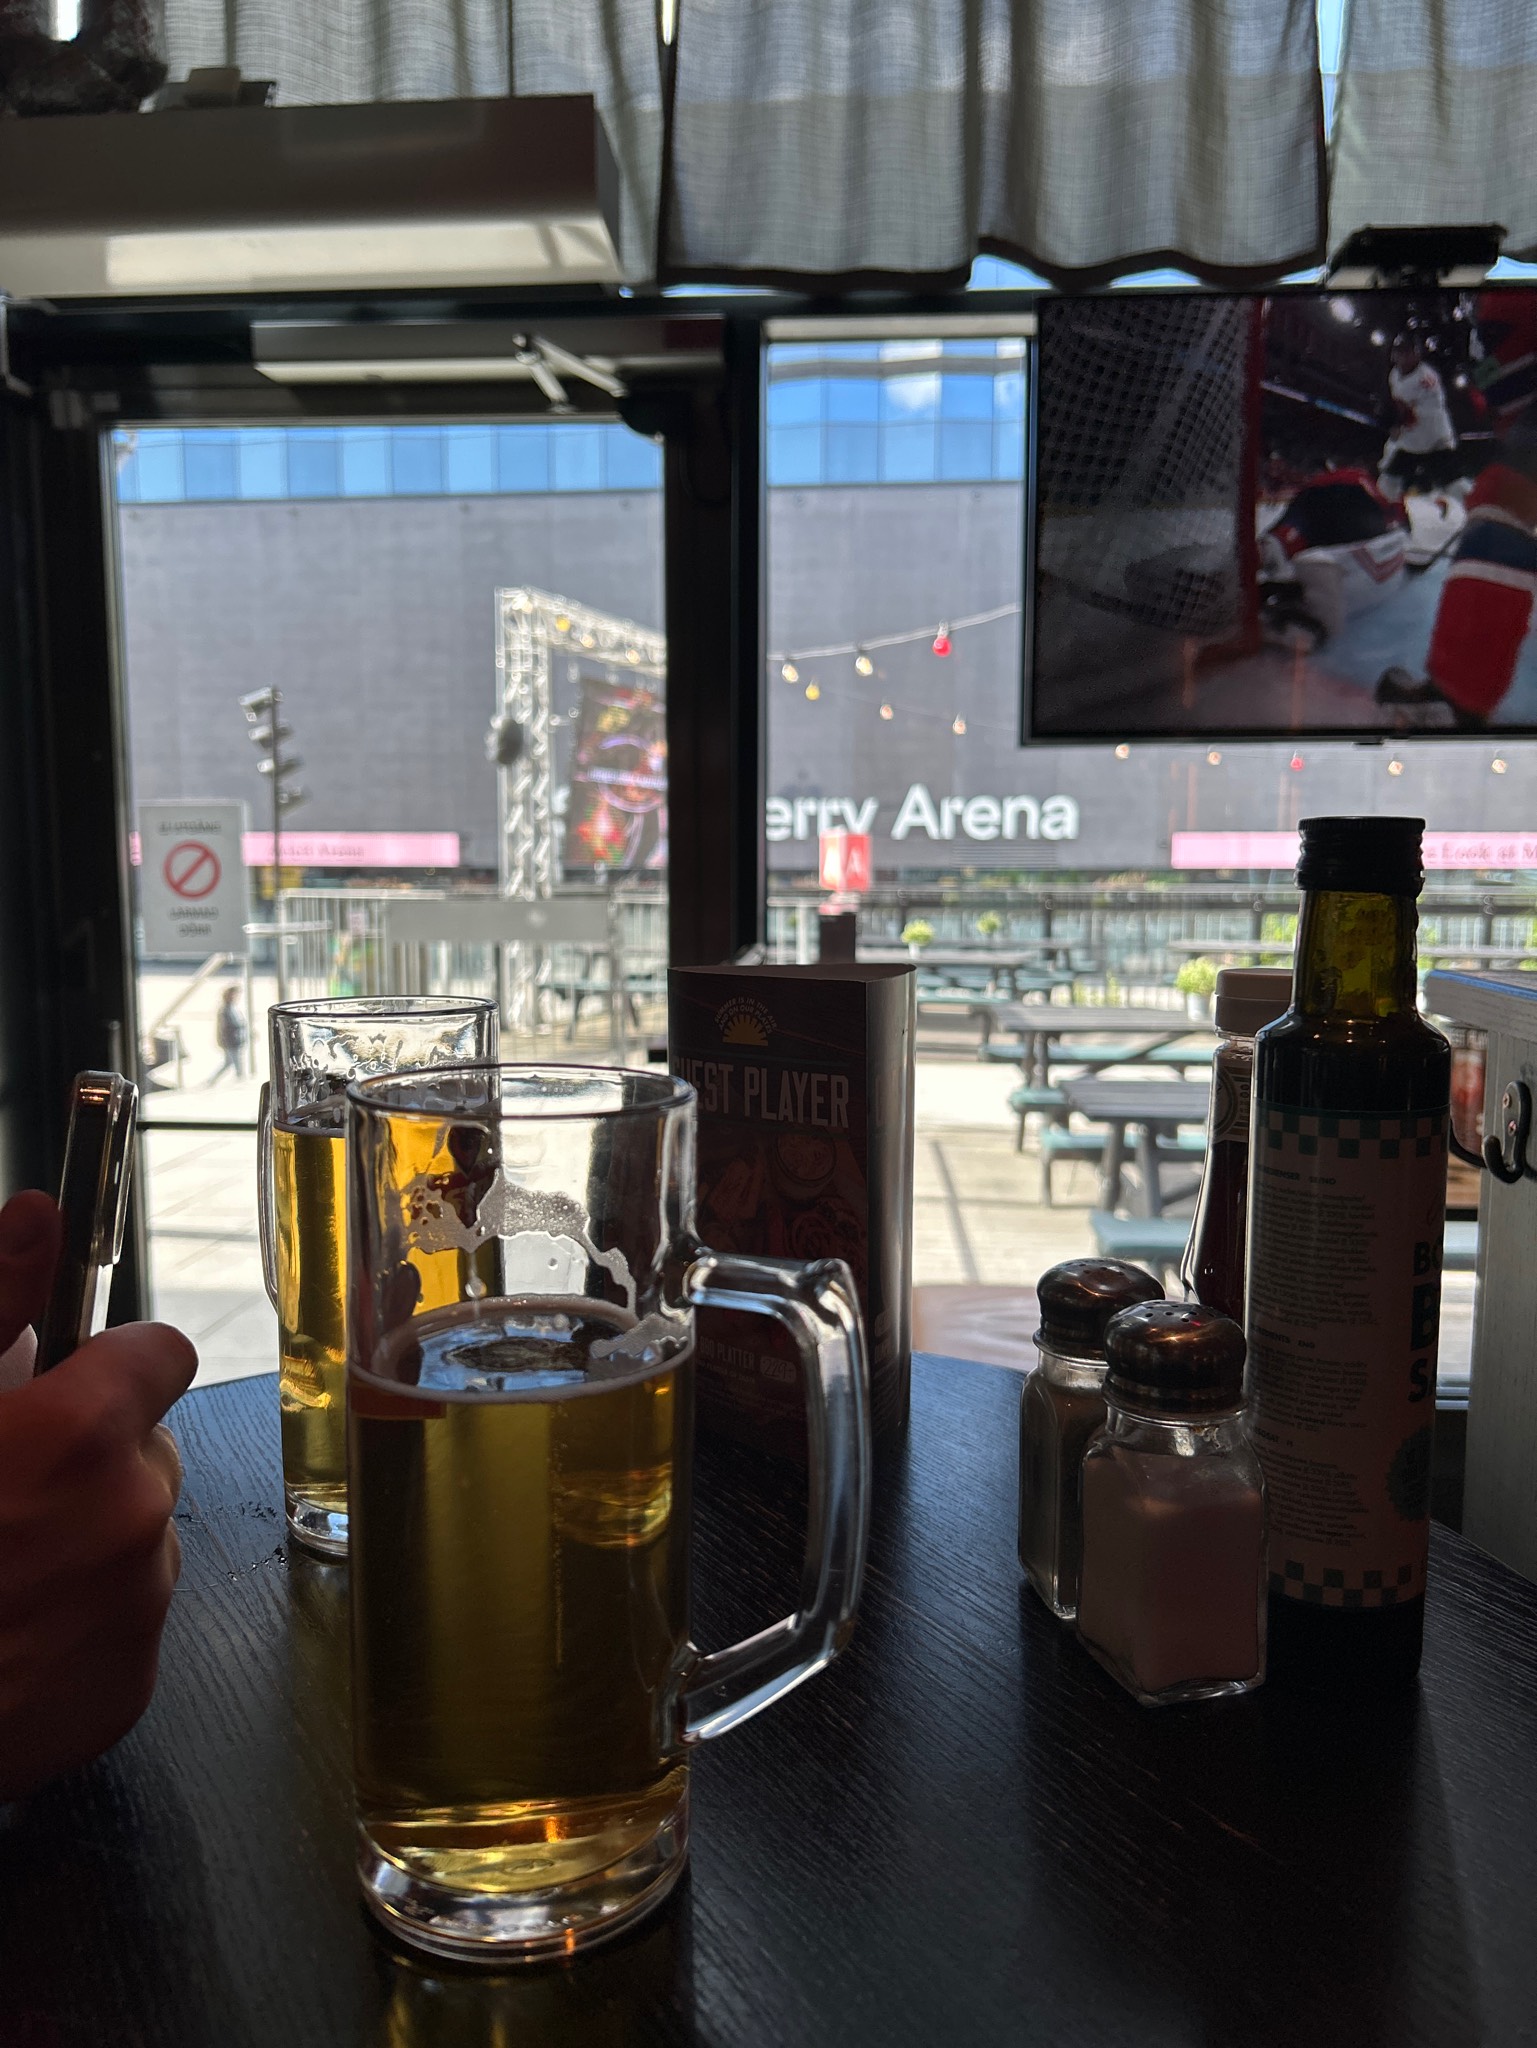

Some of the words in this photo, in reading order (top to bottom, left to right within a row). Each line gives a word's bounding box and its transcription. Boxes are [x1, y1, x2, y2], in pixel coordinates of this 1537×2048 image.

[890, 782, 1079, 841] Arena
[713, 997, 737, 1024] SUMMER
[737, 996, 745, 1005] IS
[745, 997, 755, 1006] IN
[755, 1001, 769, 1015] THE
[717, 1013, 731, 1031] AND
[727, 1006, 739, 1017] ON
[739, 1004, 755, 1014] OUR
[754, 1009, 774, 1035] PLATES
[744, 1066, 849, 1129] PLAYER
[717, 1342, 755, 1370] PLATTER
